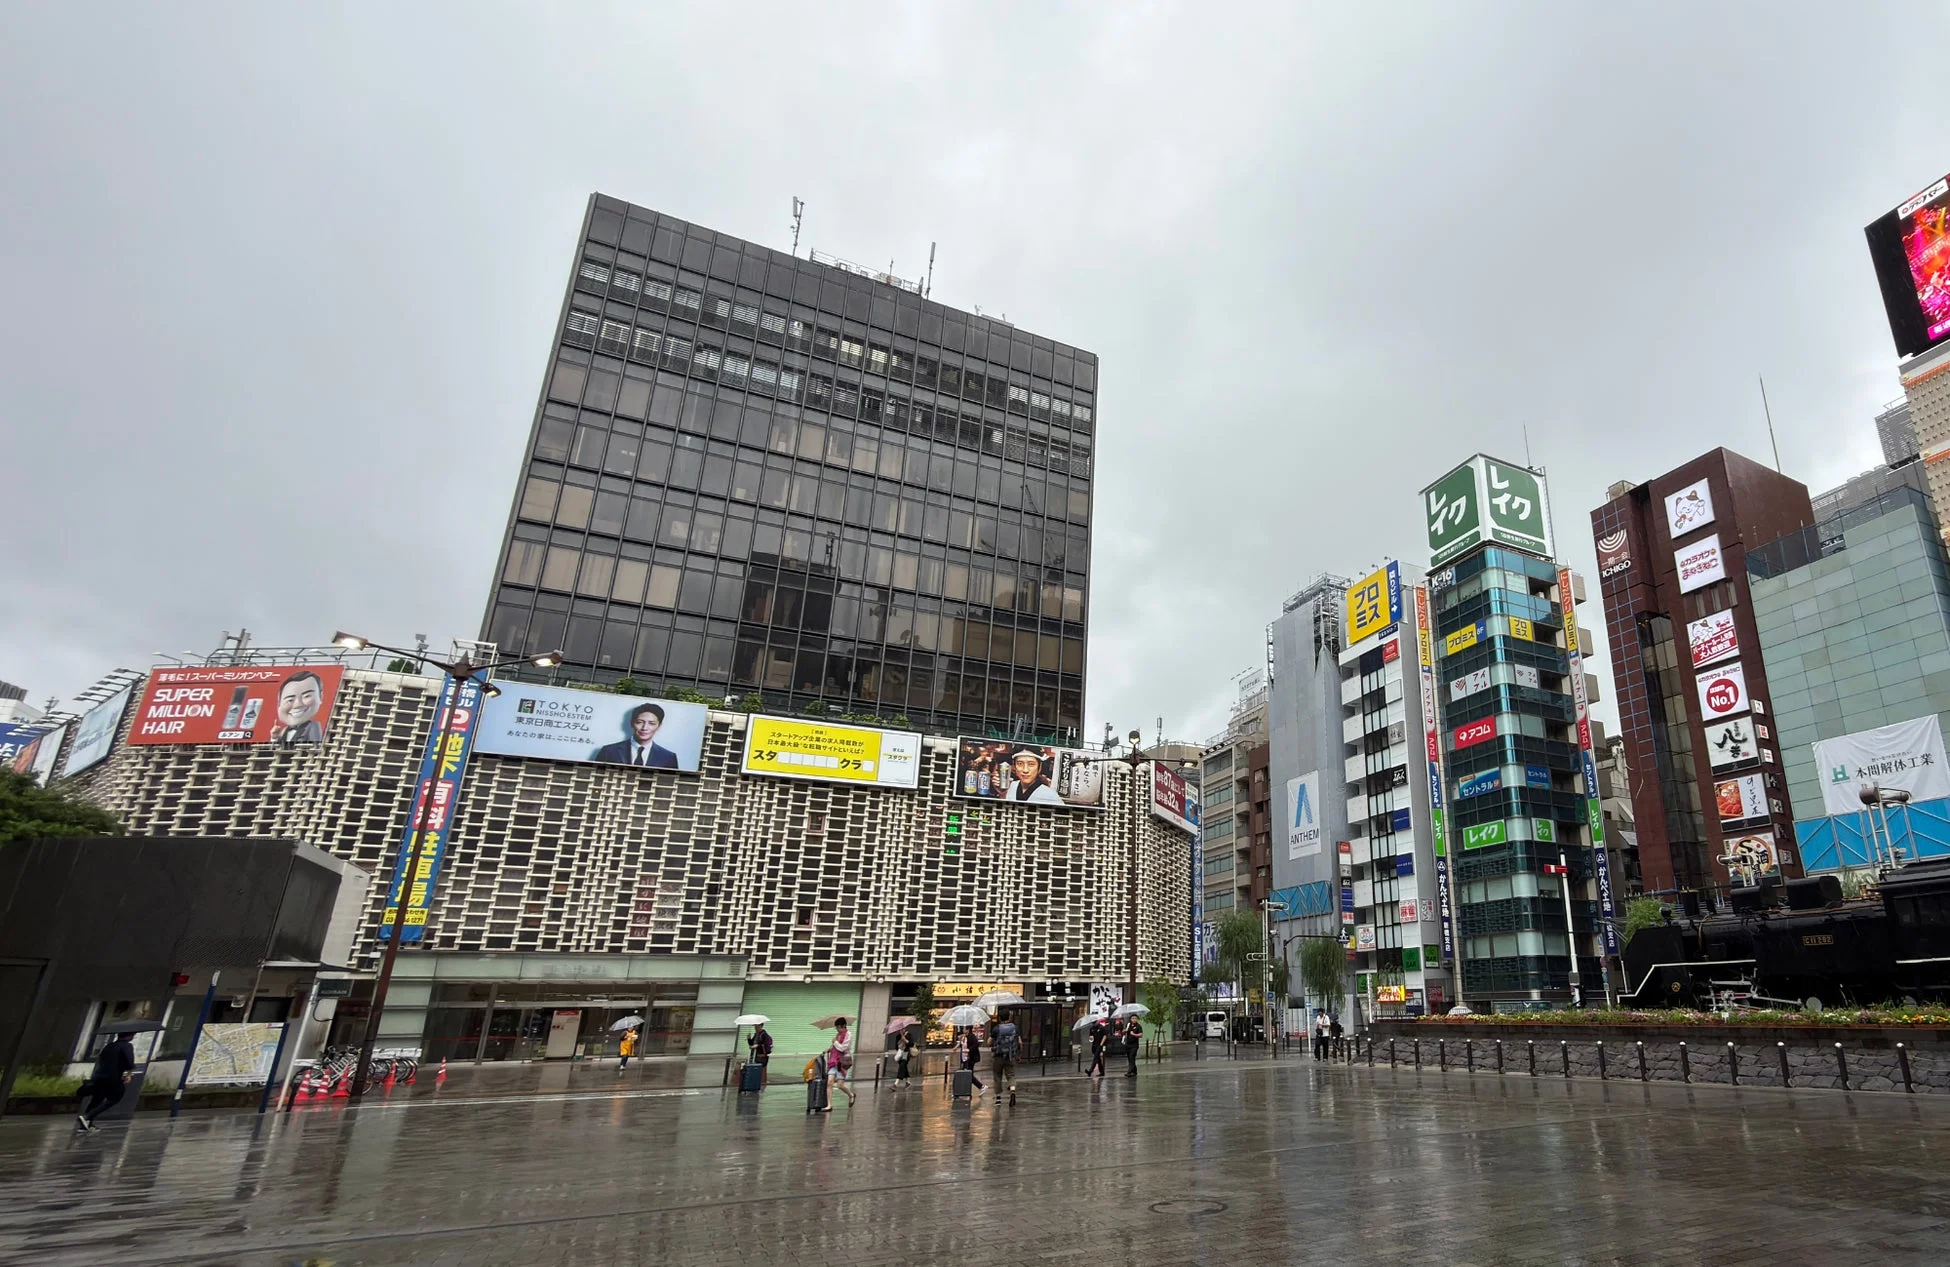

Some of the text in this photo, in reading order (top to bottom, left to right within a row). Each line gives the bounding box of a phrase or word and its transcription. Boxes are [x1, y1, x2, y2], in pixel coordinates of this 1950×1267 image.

[1602, 560, 1632, 578] ICHIGO
[1431, 568, 1453, 588] K-16
[1354, 582, 1379, 610] プロ
[1356, 602, 1381, 629] ミス
[1448, 631, 1475, 648] プロミス
[1566, 616, 1576, 647] プロミス
[153, 688, 214, 702] SUPER
[1710, 686, 1736, 708] No.1
[147, 704, 215, 719] MILLION
[536, 709, 592, 721] NISSHO ESTEM
[538, 699, 594, 714] TOKYO
[141, 721, 185, 734] HAIR
[514, 716, 589, 731] 東京日商エステム
[1468, 724, 1491, 740] アコム
[506, 730, 595, 745] あなたの家は、ここにある。
[752, 749, 863, 770] スタ クラ
[1856, 753, 1935, 779] 本間解体工業
[1462, 782, 1494, 797] セントラル
[1290, 828, 1320, 845] ANTHEM
[1469, 824, 1499, 844] レイク
[1437, 873, 1449, 918] かんべ土地
[1598, 866, 1612, 912] かんべ土地
